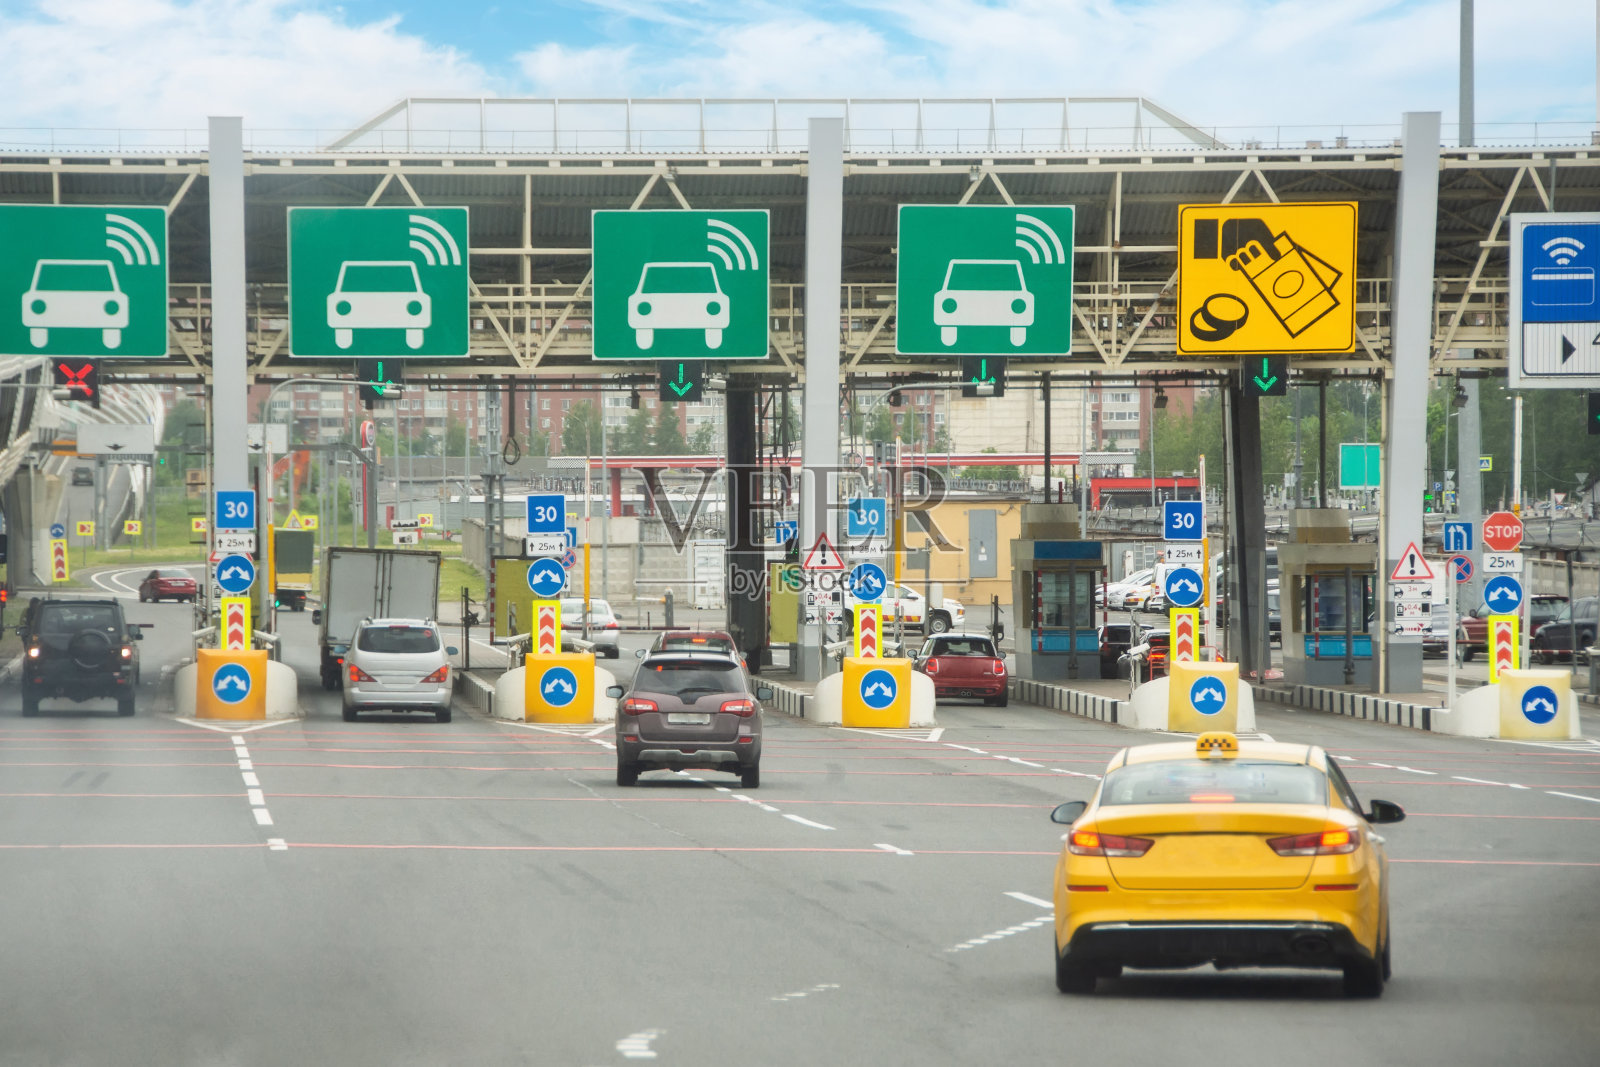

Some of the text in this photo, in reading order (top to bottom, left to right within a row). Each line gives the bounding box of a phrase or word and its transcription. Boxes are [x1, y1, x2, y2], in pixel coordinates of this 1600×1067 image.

[225, 501, 248, 518] 30
[535, 506, 557, 522] 30
[856, 509, 879, 525] 30
[1172, 512, 1195, 528] 30
[1485, 525, 1521, 538] STOP
